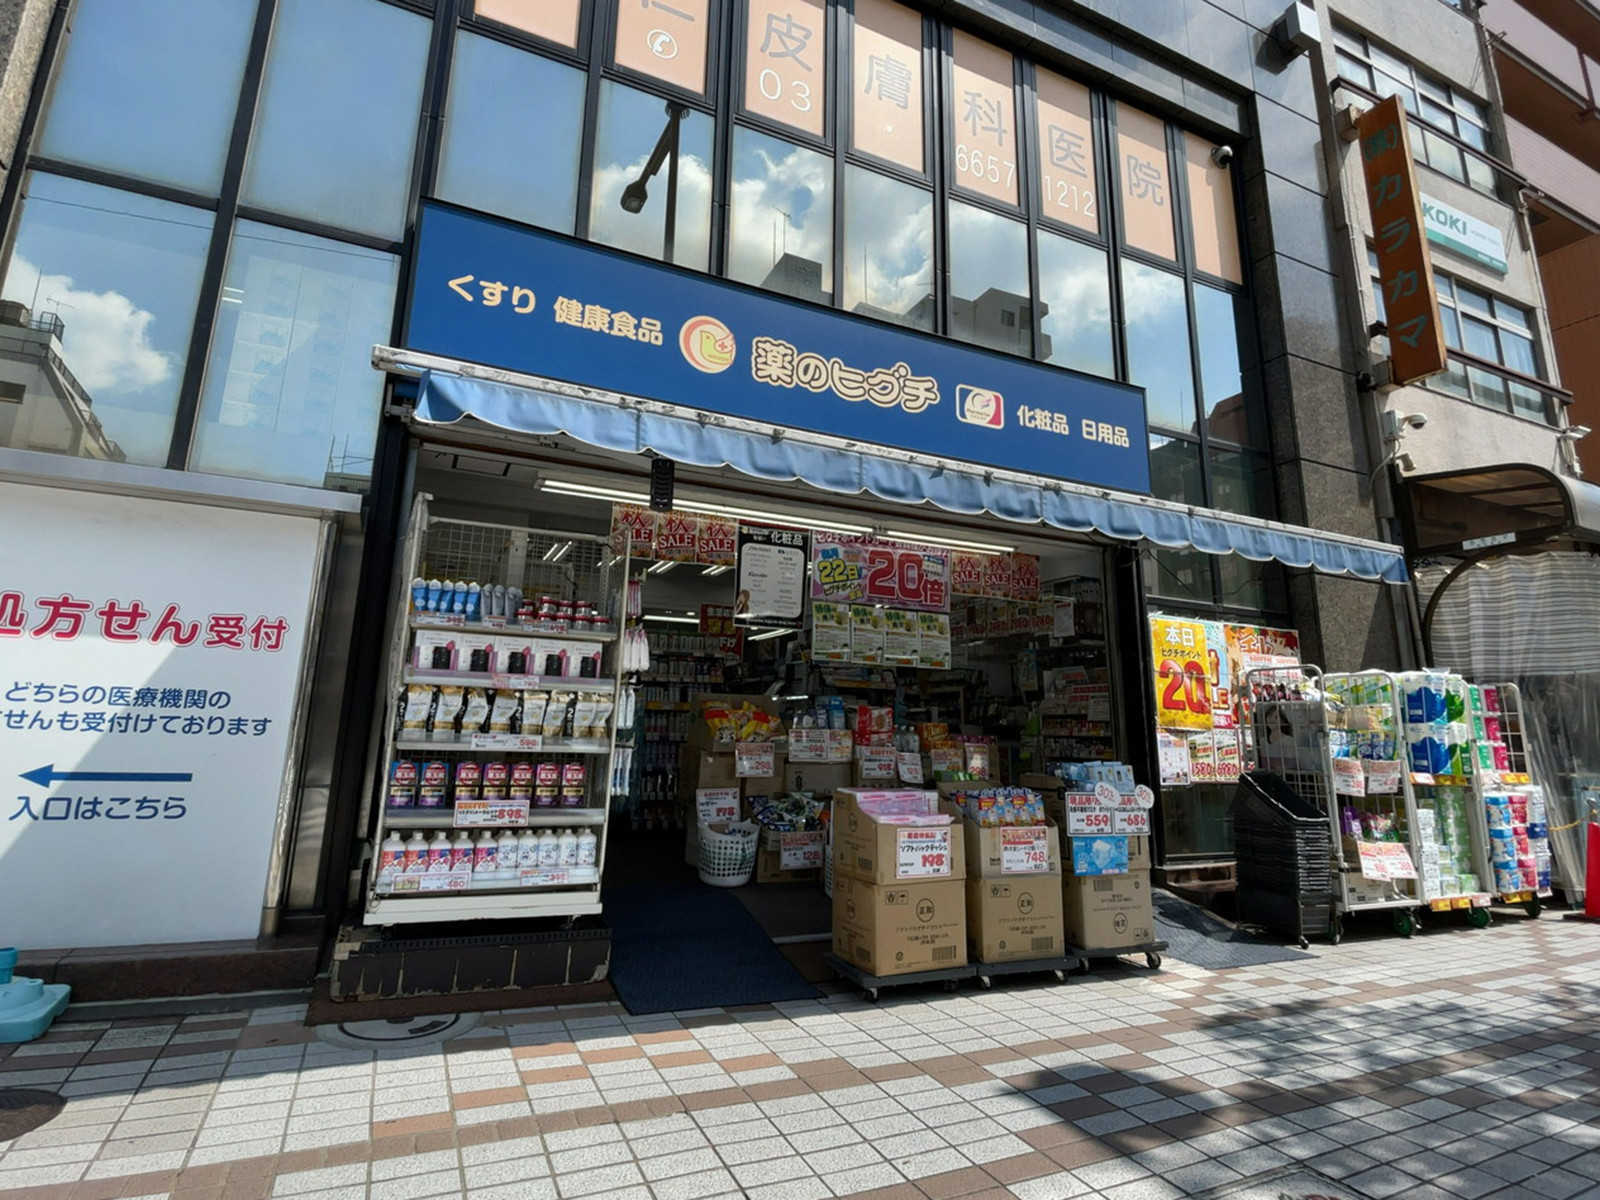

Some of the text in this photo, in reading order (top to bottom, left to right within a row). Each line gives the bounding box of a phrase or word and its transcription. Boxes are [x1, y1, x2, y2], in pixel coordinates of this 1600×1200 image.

[759, 68, 1095, 217] 03 6657 1212
[448, 274, 1130, 448] くすり 健康食品 薬のヒグチ 化粧品 日用品
[665, 516, 690, 533] 秋
[705, 522, 730, 538] 秋
[614, 529, 651, 544] SLE
[659, 534, 694, 549] SALE
[771, 531, 804, 546] 化粧品
[700, 539, 733, 552] SALE
[953, 569, 980, 584] SALE
[985, 573, 1010, 587] SALE
[1013, 578, 1038, 592] SALE
[1165, 626, 1195, 648] 本日
[1161, 647, 1202, 660] ヒグチポイント
[5, 681, 232, 710] どちらの医療機関の
[0, 708, 273, 737] せんも受付けております
[520, 739, 538, 747] 598
[755, 761, 772, 770] 298
[8, 796, 188, 821] 入口はこちら
[497, 809, 522, 819] 898
[1086, 815, 1109, 826] 559
[803, 851, 820, 860] 128
[1025, 851, 1045, 863] 748
